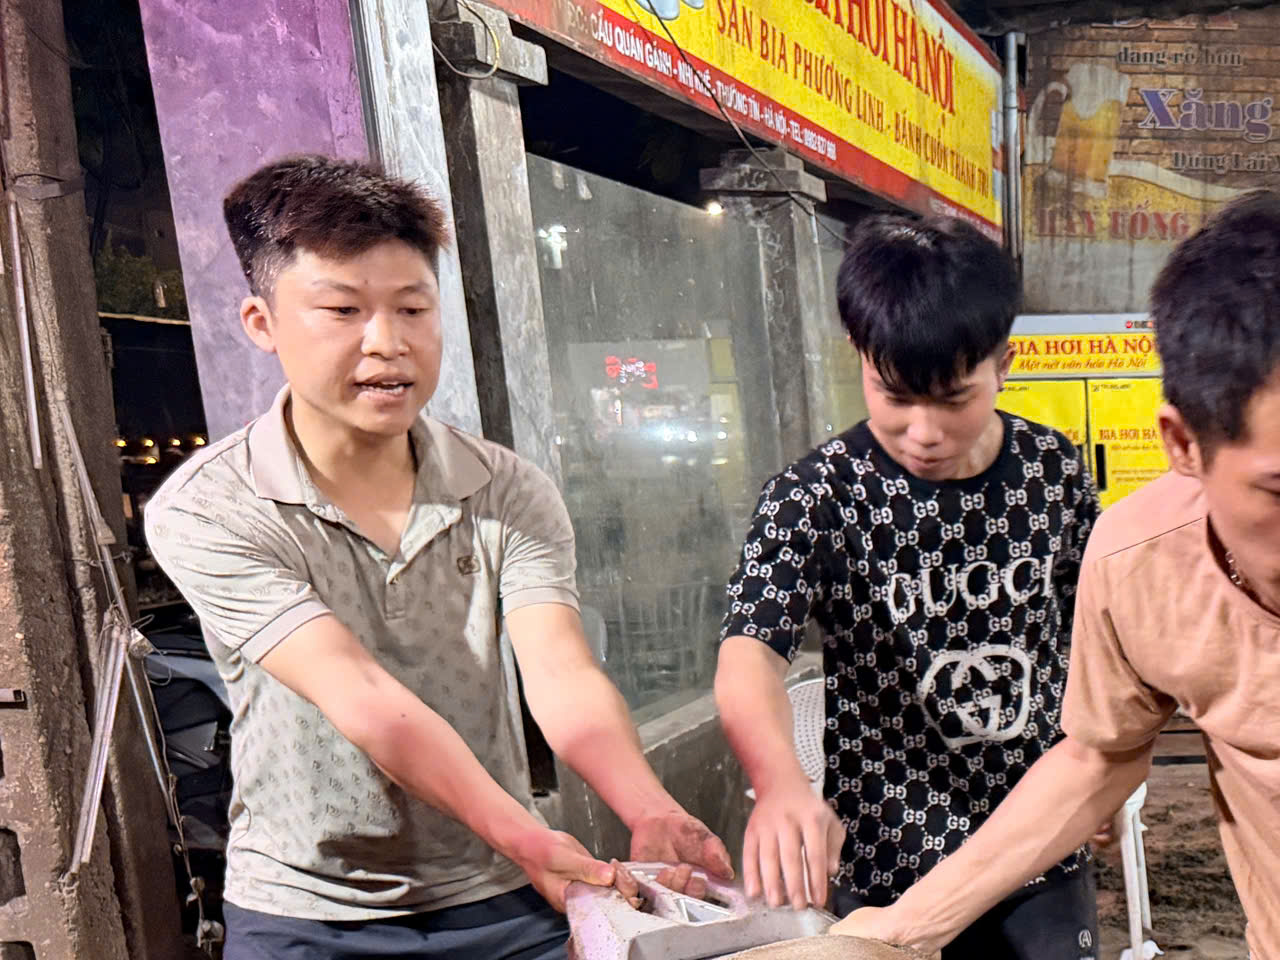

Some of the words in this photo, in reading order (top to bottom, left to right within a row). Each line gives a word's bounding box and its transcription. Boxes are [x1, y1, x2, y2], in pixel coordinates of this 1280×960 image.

[614, 26, 644, 63] QUÁN
[760, 18, 788, 74] BIA
[856, 85, 884, 133] LINH
[895, 109, 922, 159] BÁNH
[922, 27, 955, 128] NỘI
[1138, 87, 1273, 143] Xăng
[1045, 338, 1082, 355] HƠI
[1089, 335, 1118, 354] HÀ
[888, 553, 1054, 624] GUCCI
